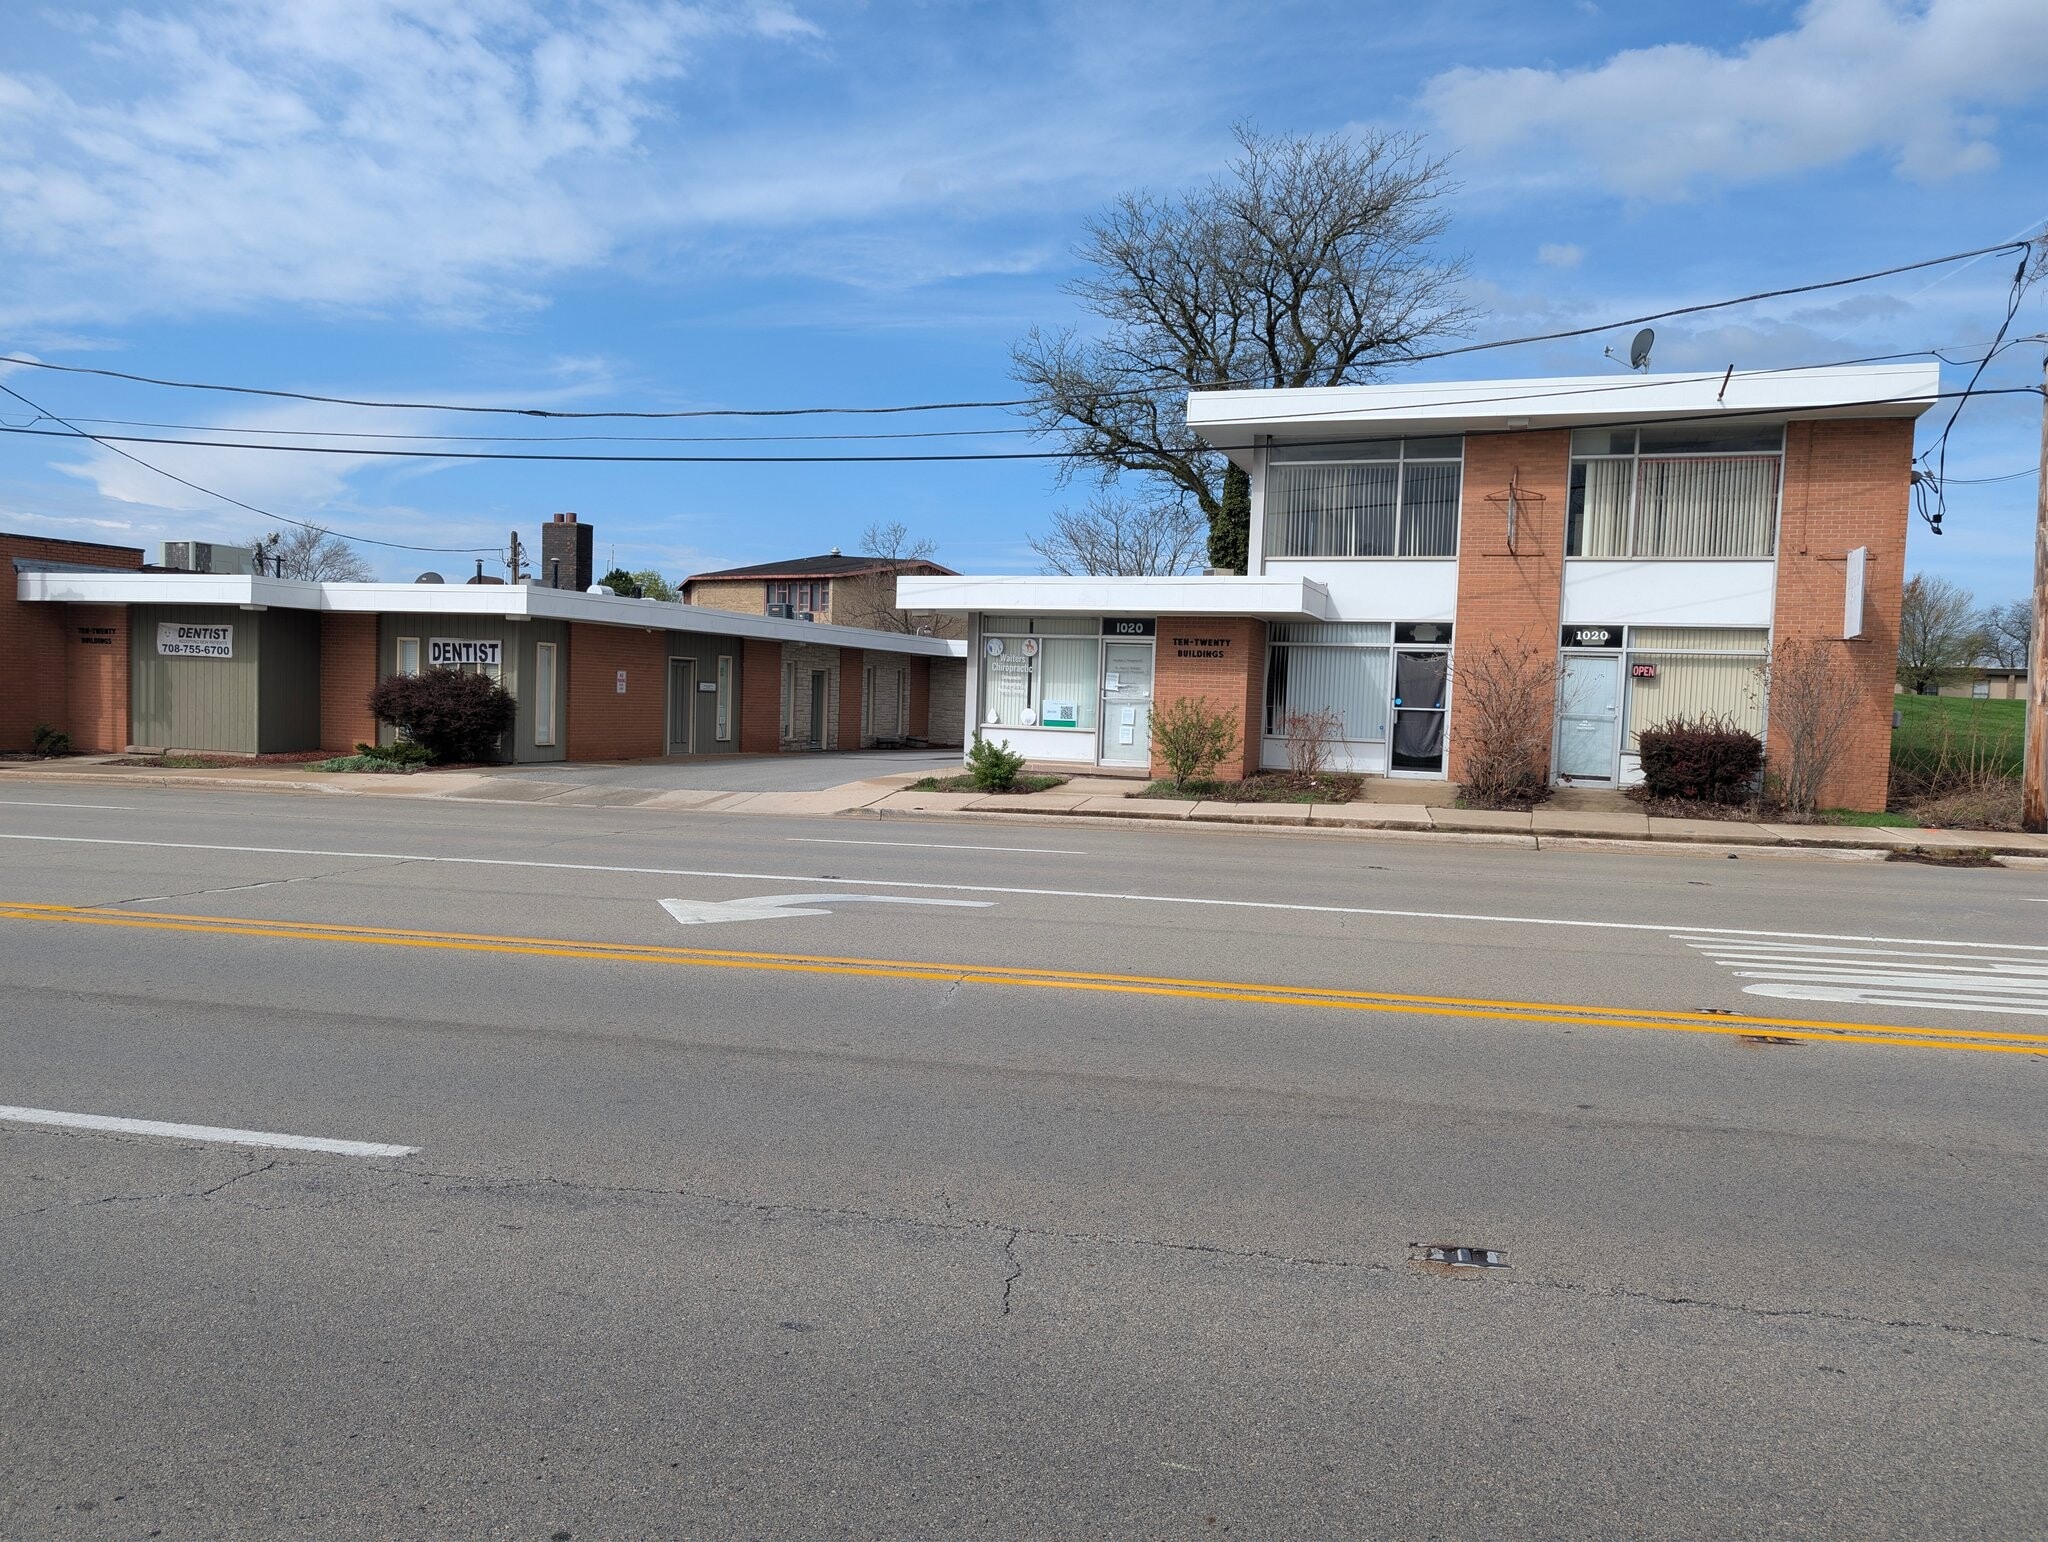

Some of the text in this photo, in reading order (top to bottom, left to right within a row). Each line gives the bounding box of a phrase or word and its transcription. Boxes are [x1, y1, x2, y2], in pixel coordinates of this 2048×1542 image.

[178, 627, 229, 639] DENTIST
[1116, 622, 1144, 633] 1020
[1576, 631, 1608, 640] 1020
[1173, 638, 1231, 646] TEN-TWENTY
[162, 643, 230, 655] 708-755-6700
[432, 642, 499, 662] DENTIST
[1178, 650, 1224, 658] BUILDINGS
[991, 662, 1033, 674] Chiropractic
[1633, 665, 1655, 677] OPEN
